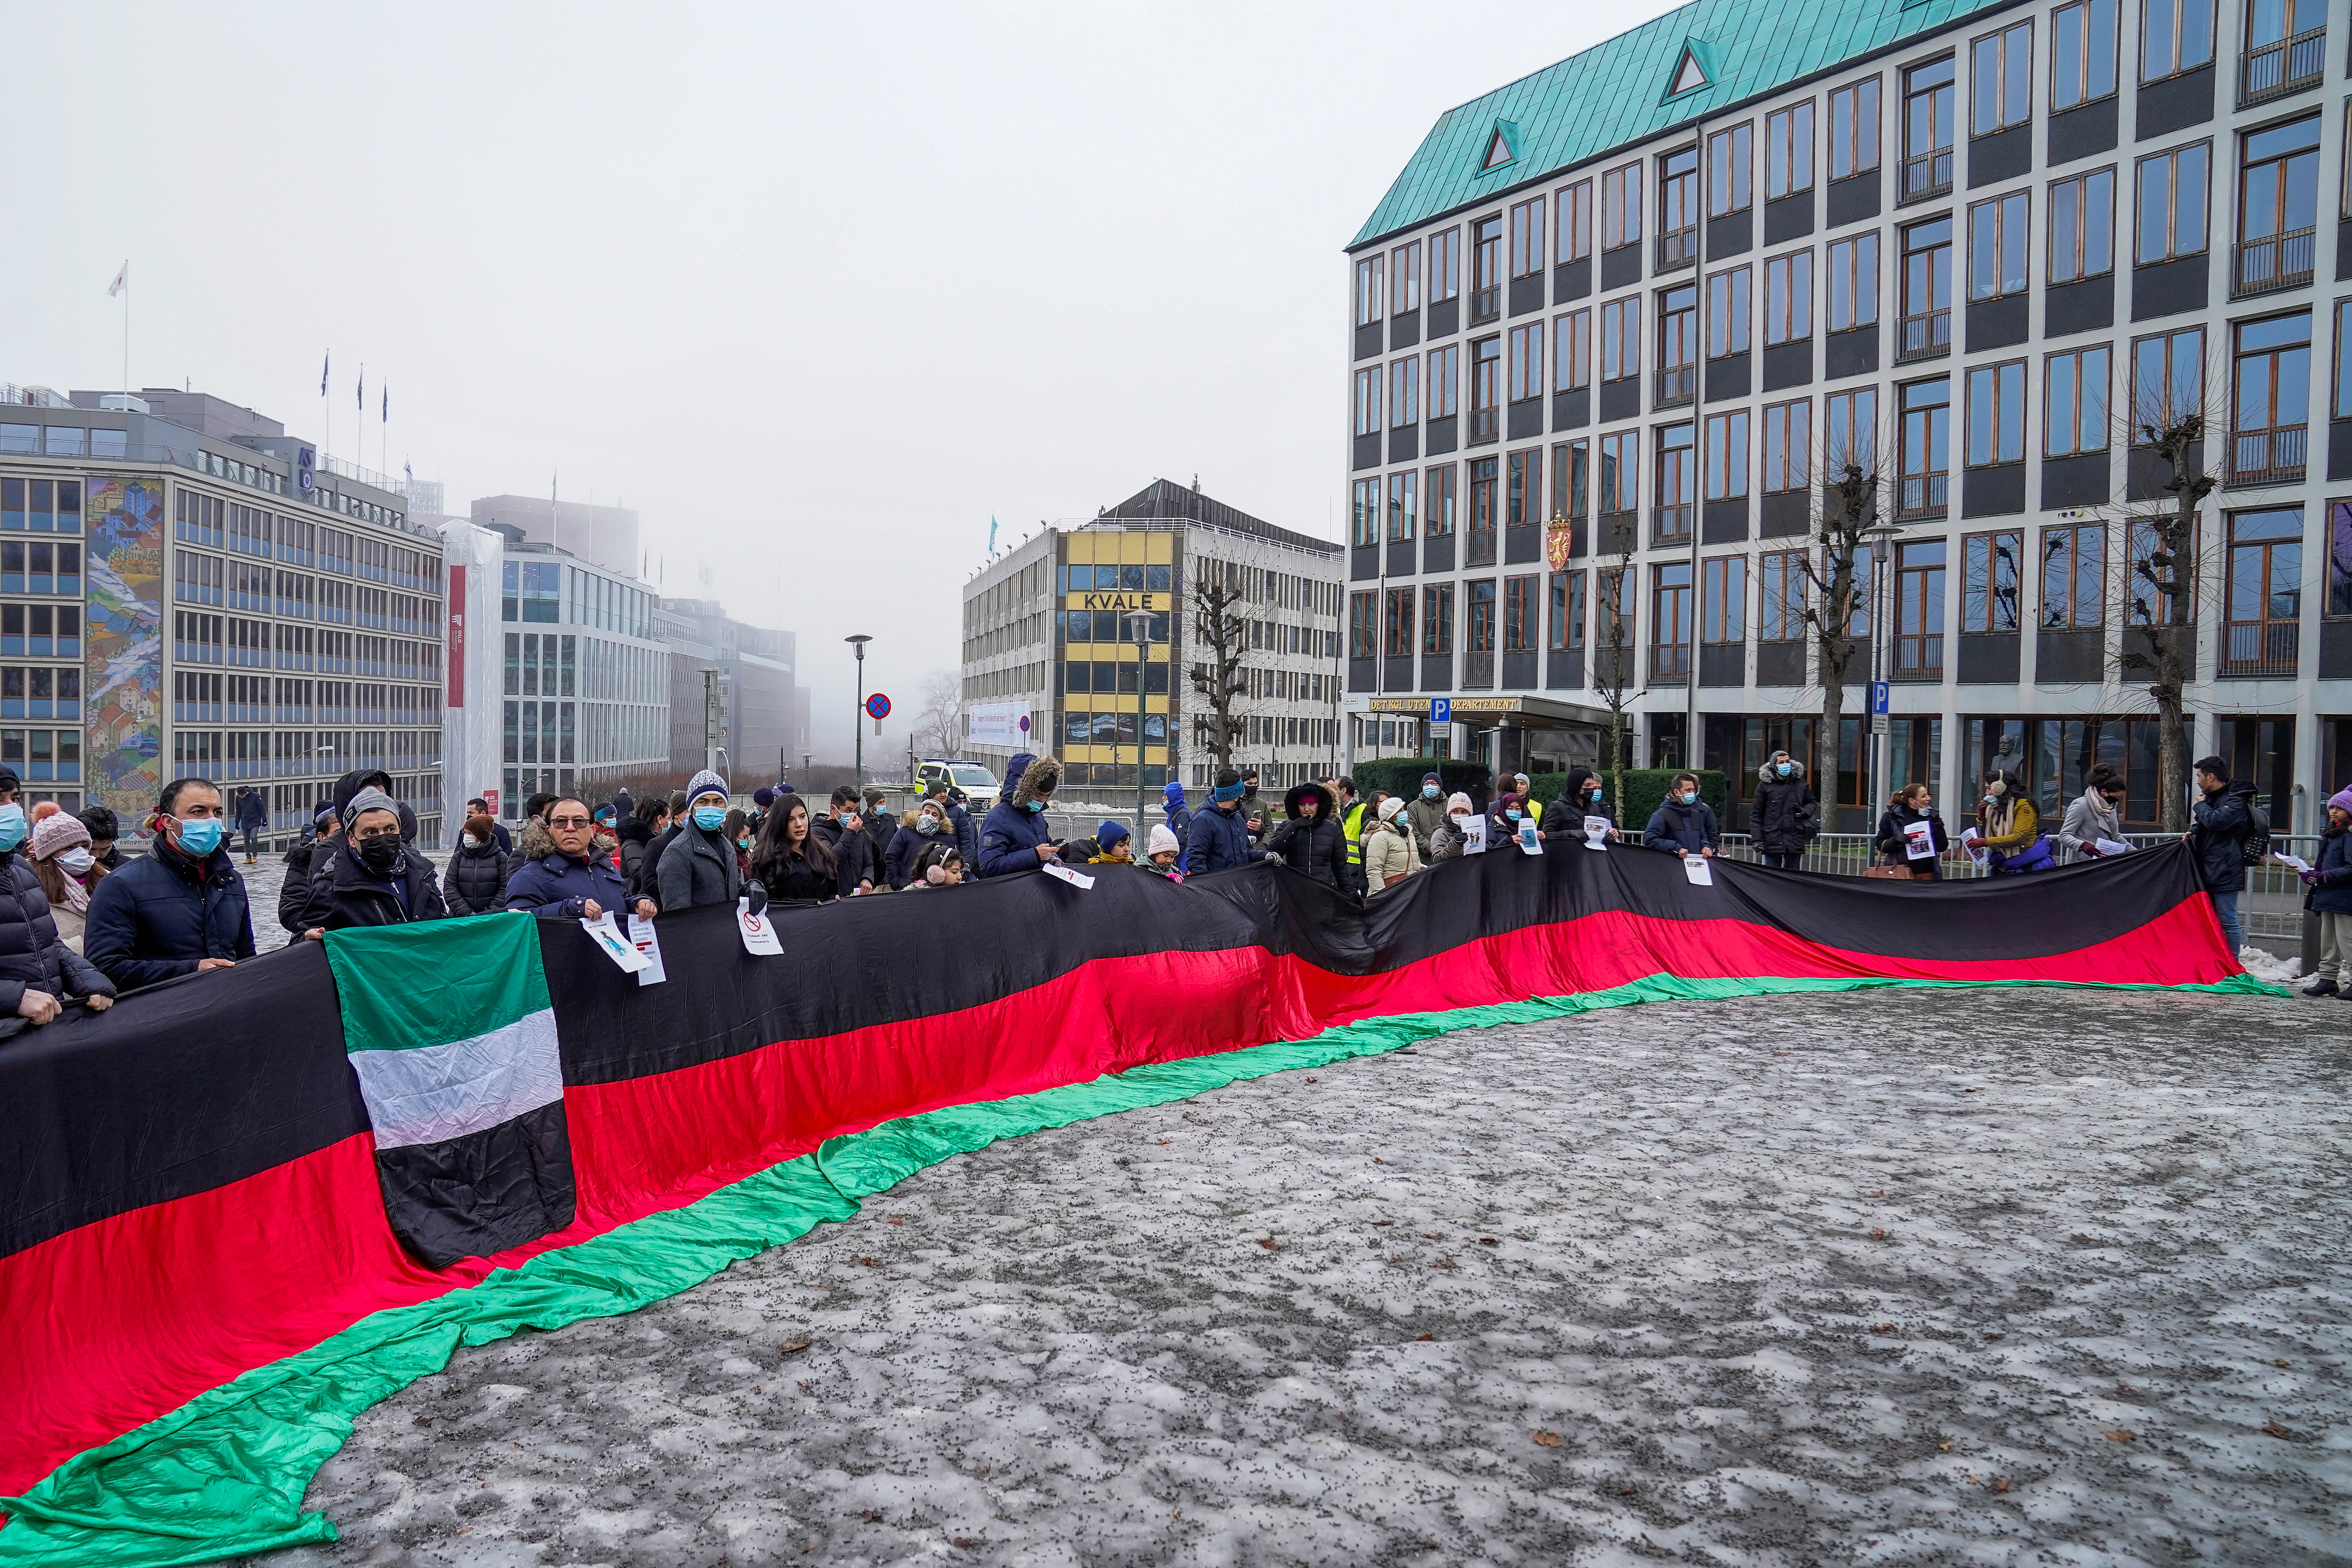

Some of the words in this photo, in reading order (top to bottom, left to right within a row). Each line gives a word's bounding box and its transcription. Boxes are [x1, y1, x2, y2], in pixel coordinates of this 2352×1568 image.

[1085, 594, 1152, 609] KVALE
[1371, 700, 1388, 710] DET
[1388, 700, 1406, 710] KGL.
[1876, 685, 1886, 710] P
[1435, 701, 1446, 719] P
